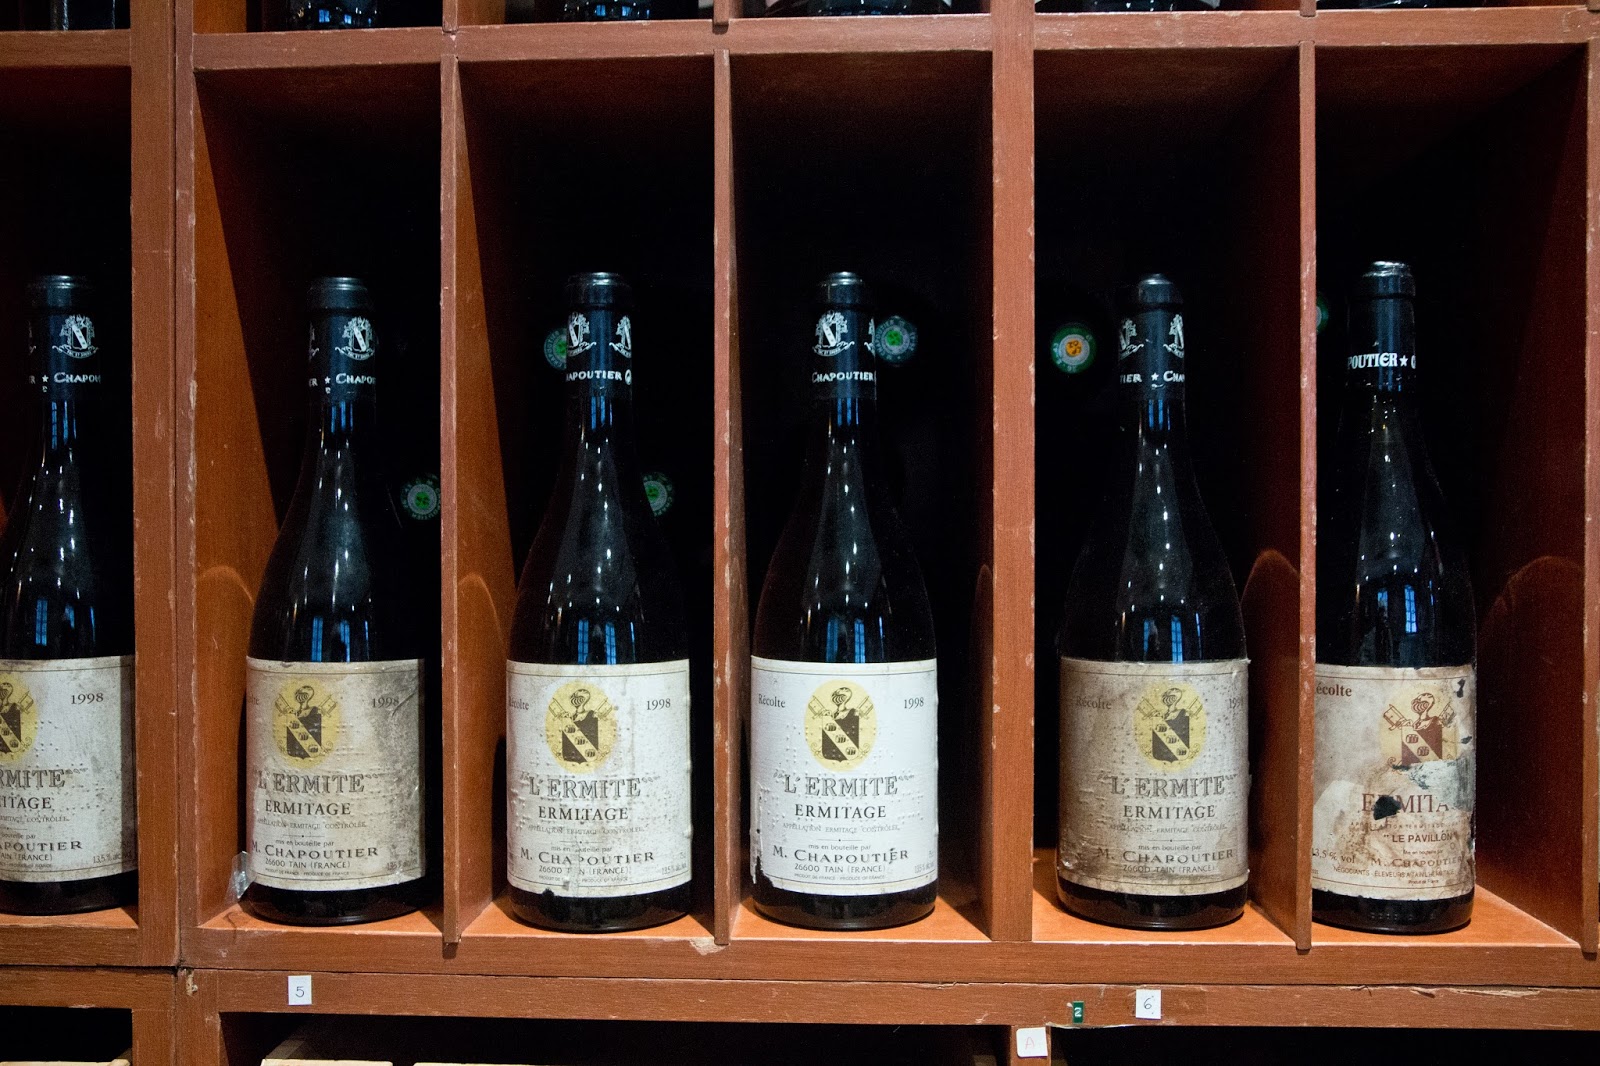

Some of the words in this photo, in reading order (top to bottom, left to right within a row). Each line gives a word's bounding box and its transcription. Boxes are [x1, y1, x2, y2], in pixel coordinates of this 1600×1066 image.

[812, 372, 873, 383] CHAPOUTIER
[1315, 682, 1352, 697] écolte
[71, 693, 104, 704] 1998
[371, 697, 399, 708] 1998
[646, 698, 671, 710] 1998
[758, 694, 785, 709] Récolte
[904, 697, 924, 708] 1998
[0, 795, 51, 809] ITAGE
[265, 799, 351, 815] ERMITAGE
[538, 805, 629, 821] ERMITAGE
[795, 804, 886, 819] ERMITAGE
[1123, 804, 1216, 819] ERMITAGE
[1391, 834, 1406, 843] LE
[1407, 832, 1452, 843] PAVILLON
[0, 841, 82, 852] POUTIER
[264, 844, 378, 860] CHAPOUTIER
[772, 845, 788, 859] M.
[520, 846, 533, 861] M.
[1122, 849, 1234, 864] CHAPOUTIER
[1341, 854, 1356, 863] vol
[289, 860, 307, 868] TAIN
[310, 860, 351, 869] (FRANCE)
[538, 864, 563, 874] 26600
[794, 862, 820, 873] 26600
[824, 865, 844, 873] TAIN
[847, 864, 886, 874] (FRANCE)
[295, 985, 305, 998] 5
[1143, 997, 1154, 1010] 6
[1074, 1007, 1082, 1017] 2
[1025, 1036, 1035, 1050] A
